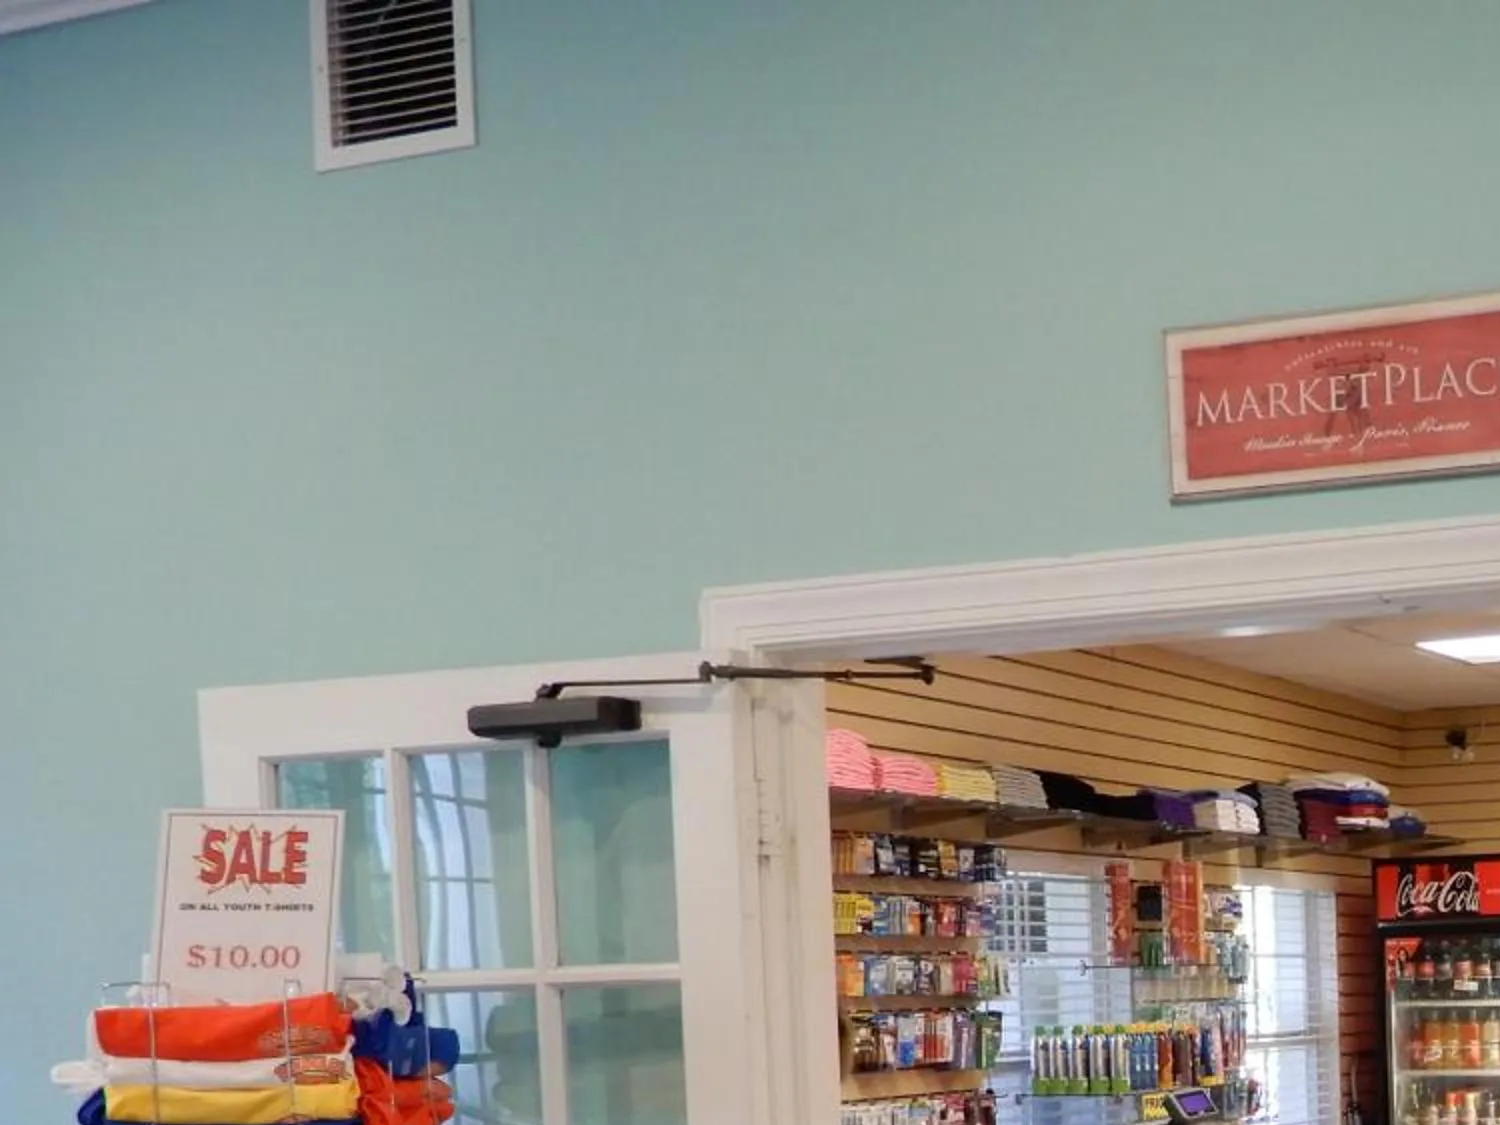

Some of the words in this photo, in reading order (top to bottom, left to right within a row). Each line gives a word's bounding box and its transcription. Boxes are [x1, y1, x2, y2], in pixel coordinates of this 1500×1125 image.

[198, 828, 309, 887] SALE
[200, 902, 219, 912] ALL
[224, 902, 262, 912] YOUTH
[1395, 870, 1481, 919] Coca-Cola
[186, 943, 301, 970] $10.00
